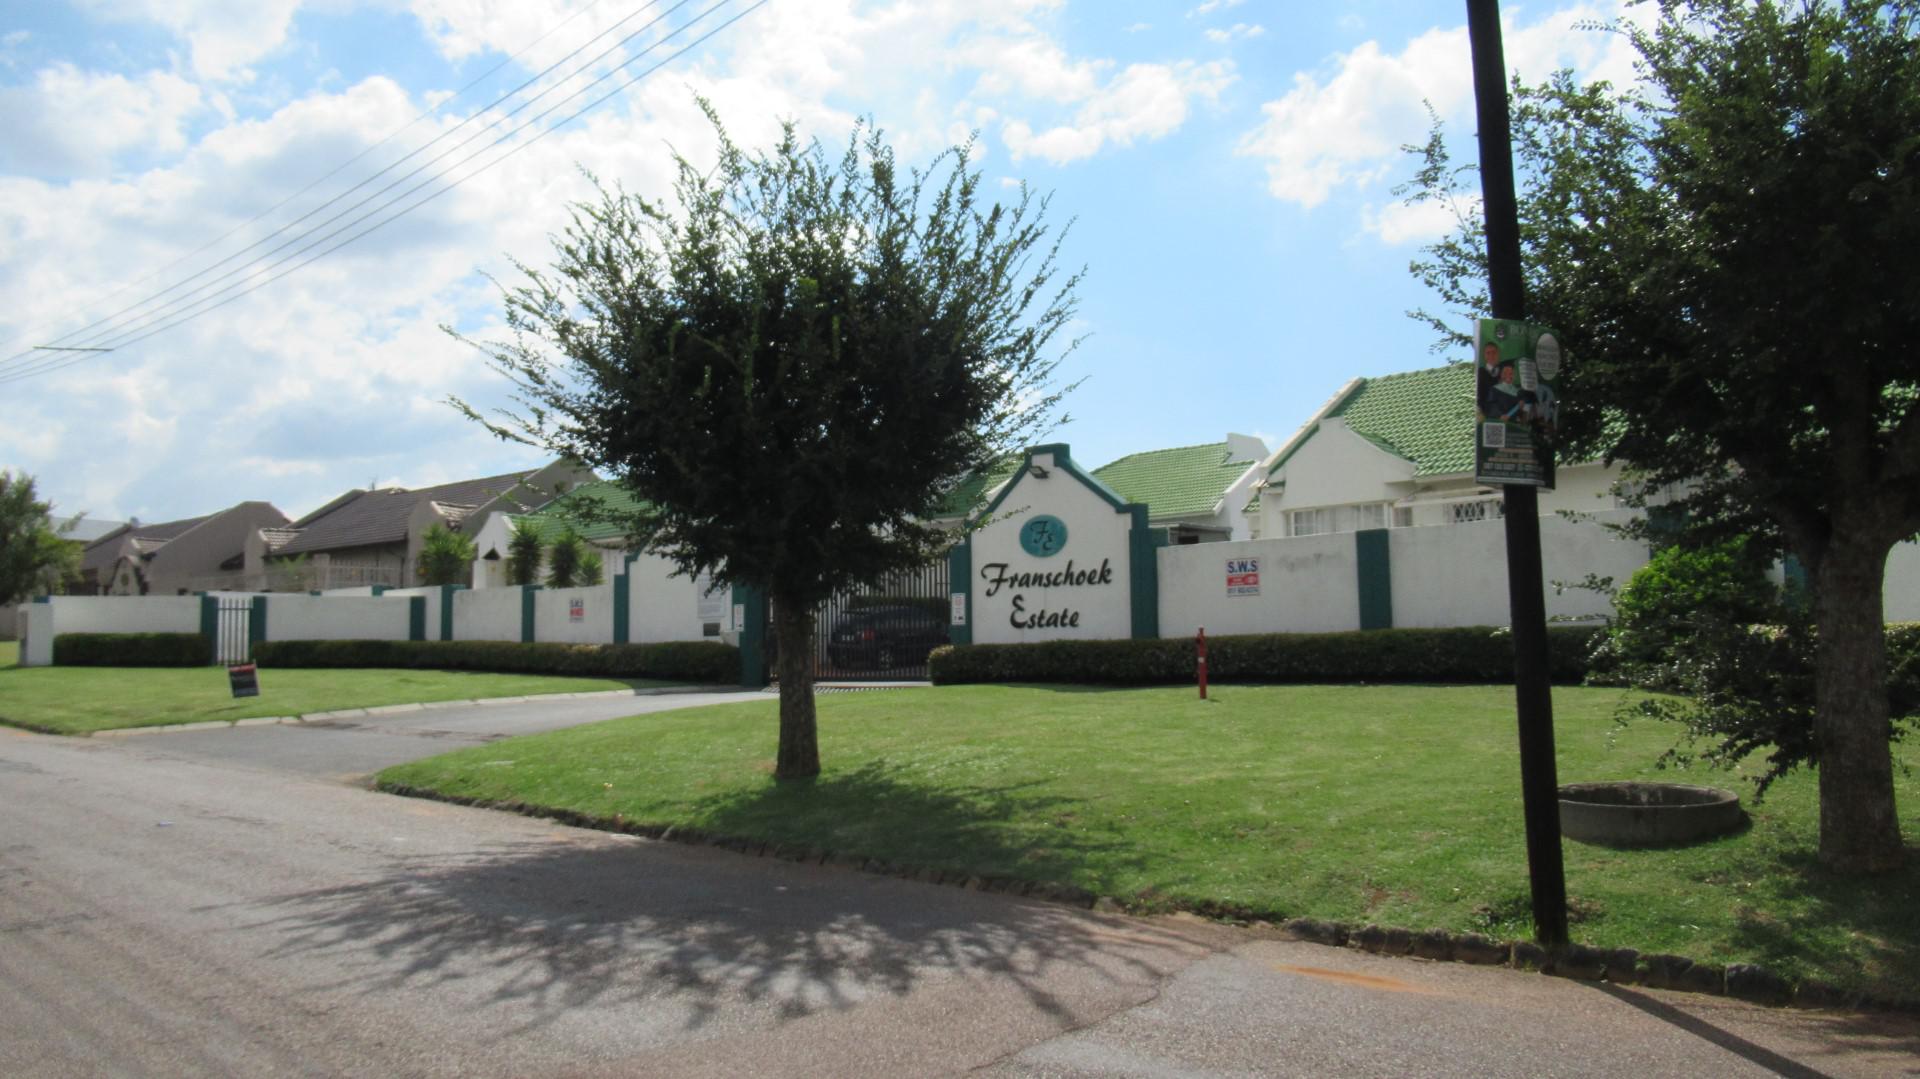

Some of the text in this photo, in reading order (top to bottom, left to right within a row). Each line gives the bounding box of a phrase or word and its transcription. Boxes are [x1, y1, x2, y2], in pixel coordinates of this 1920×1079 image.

[980, 558, 1112, 597] Franschoek
[1227, 560, 1257, 574] S.W.S
[1010, 594, 1079, 629] Estate
